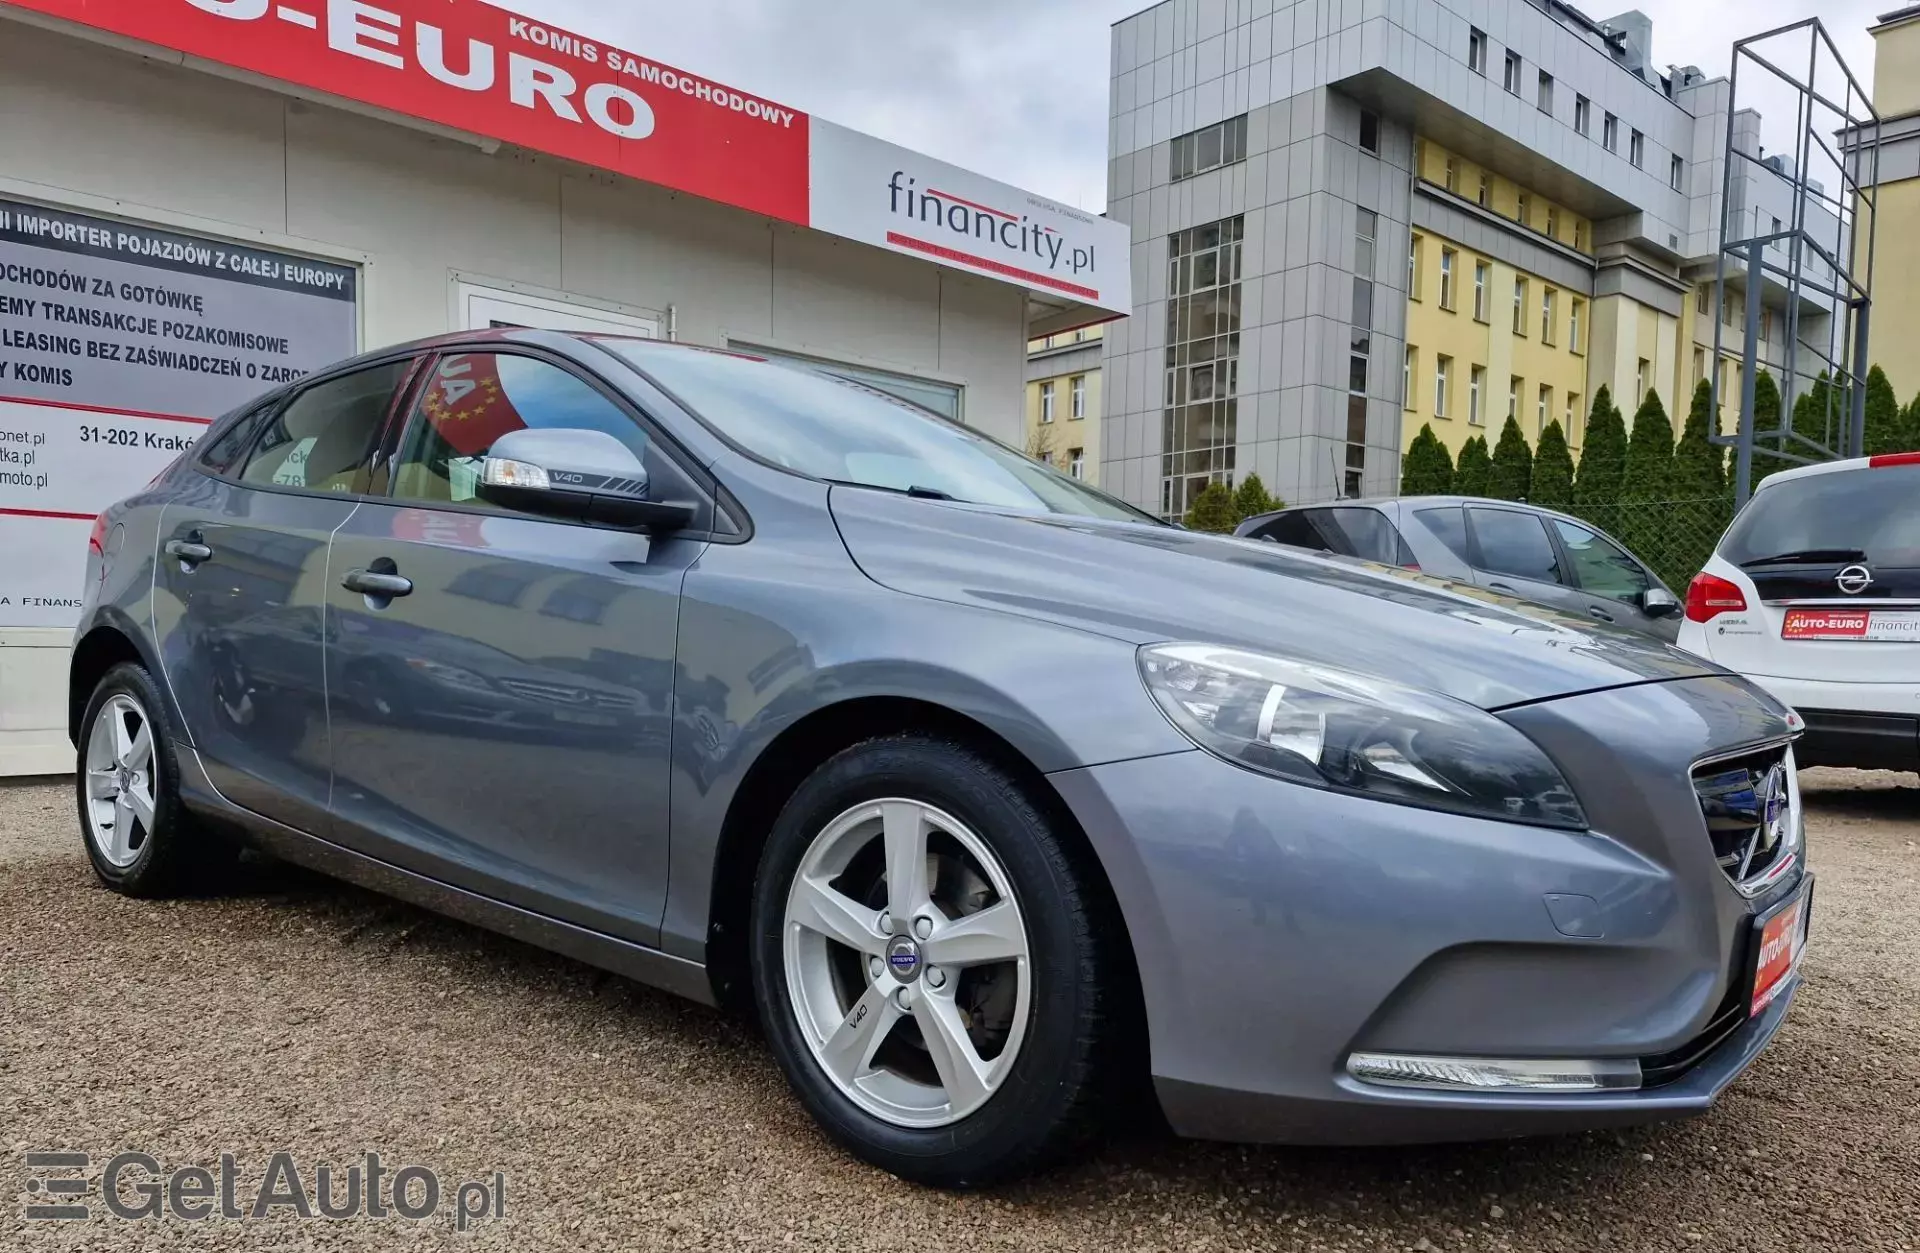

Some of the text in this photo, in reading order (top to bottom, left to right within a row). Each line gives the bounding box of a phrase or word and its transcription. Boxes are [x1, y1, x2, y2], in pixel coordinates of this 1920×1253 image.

[509, 17, 794, 128] KOMIS SAMOCHODOWY
[888, 171, 1095, 274] financity.pl
[17, 213, 112, 248] IMPORTER
[117, 233, 210, 266] POJAZDÓW
[215, 251, 226, 269] Z
[230, 254, 279, 279] CAŁEJ
[284, 264, 344, 290] EUROPY
[92, 278, 115, 298] ZA
[120, 285, 203, 317] GOTÓWKĘ
[42, 302, 157, 336] TRANSAKCJE
[162, 320, 289, 355] POZAKOMISOWE
[3, 328, 309, 383] LEASING BEZ ZAŚWIADCZEŃ O ZARO
[14, 362, 73, 386] KOMIS
[80, 425, 139, 447] 31-202
[554, 472, 583, 484] V40
[22, 597, 82, 608] FINANS
[1791, 618, 1864, 630] AUTO-EURO
[849, 1004, 867, 1029] V40
